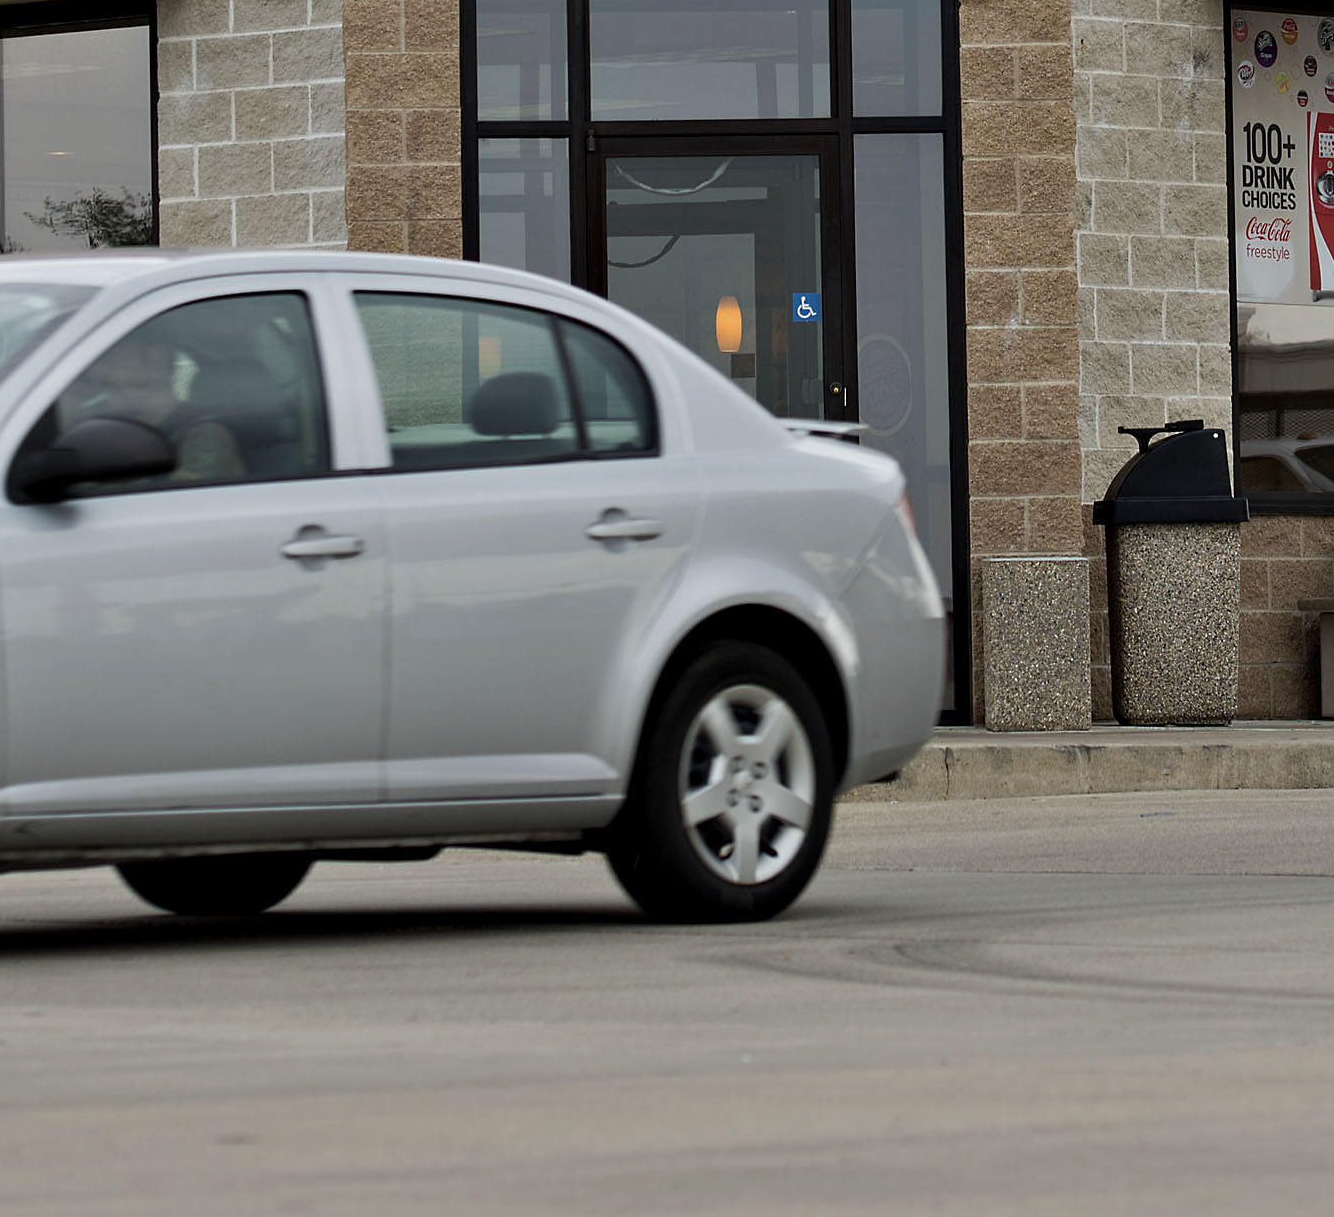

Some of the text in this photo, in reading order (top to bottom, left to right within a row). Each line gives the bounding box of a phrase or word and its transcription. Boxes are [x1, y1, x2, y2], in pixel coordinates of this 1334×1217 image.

[1243, 121, 1296, 165] 100+
[1242, 164, 1295, 190] DRINK
[1242, 190, 1296, 210] CHOICES
[1245, 216, 1292, 242] Coca-Cola
[1245, 243, 1291, 262] freestyle
